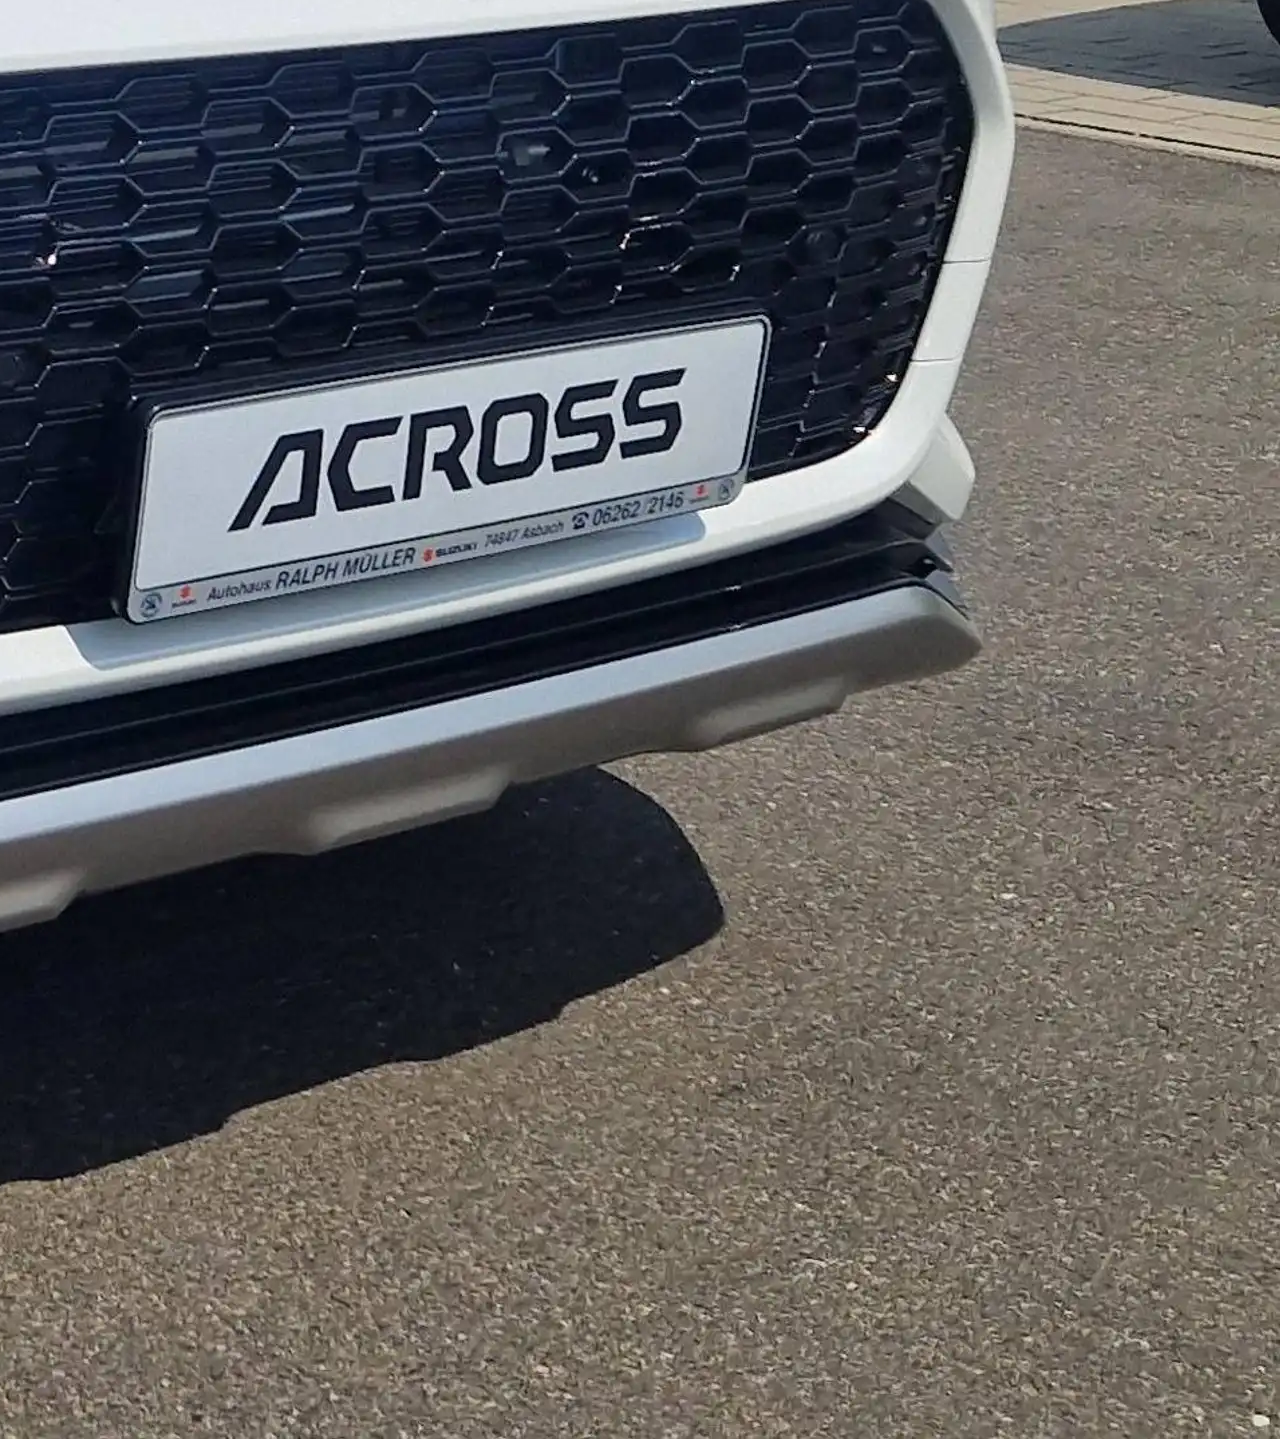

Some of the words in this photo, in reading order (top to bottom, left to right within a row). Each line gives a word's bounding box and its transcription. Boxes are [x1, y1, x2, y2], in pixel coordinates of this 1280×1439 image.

[227, 367, 688, 532] ACROSS
[206, 578, 272, 602] Autohaus
[276, 560, 338, 590] RALPH
[342, 546, 416, 578] MÜLLER
[435, 542, 478, 558] SUZUKI
[592, 500, 642, 527] 06262
